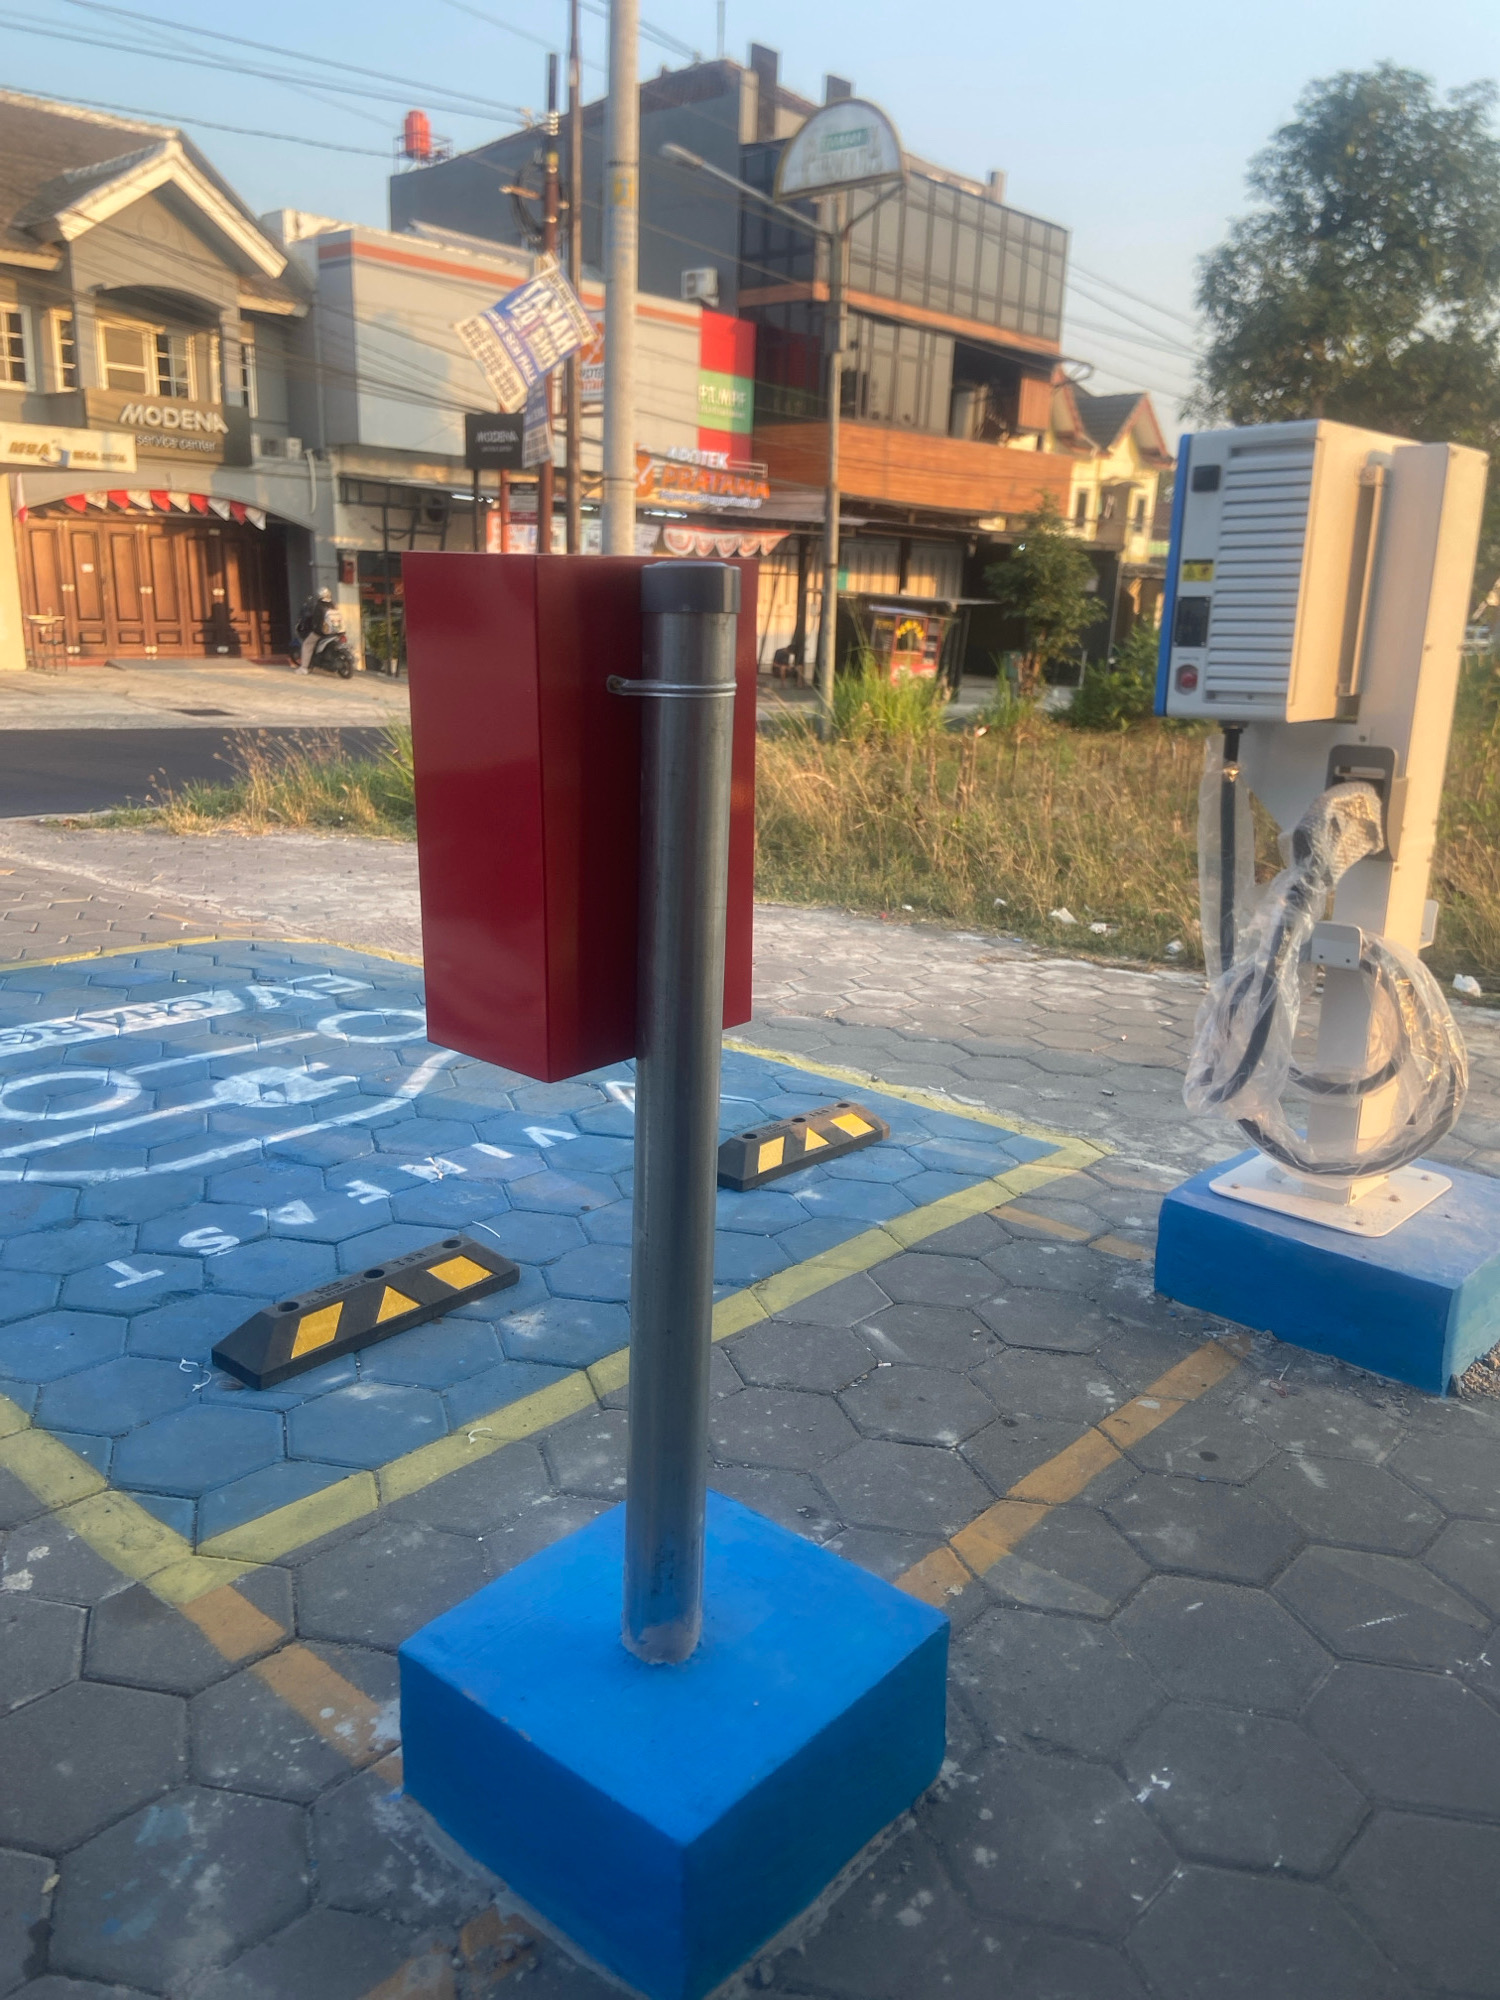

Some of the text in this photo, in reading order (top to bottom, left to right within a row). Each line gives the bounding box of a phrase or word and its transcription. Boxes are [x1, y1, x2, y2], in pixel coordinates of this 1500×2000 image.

[119, 403, 229, 434] MODENA
[136, 433, 216, 452] service center
[667, 445, 730, 469] APOTEK
[661, 464, 771, 499] PRATAMA
[246, 973, 374, 1010] EV
